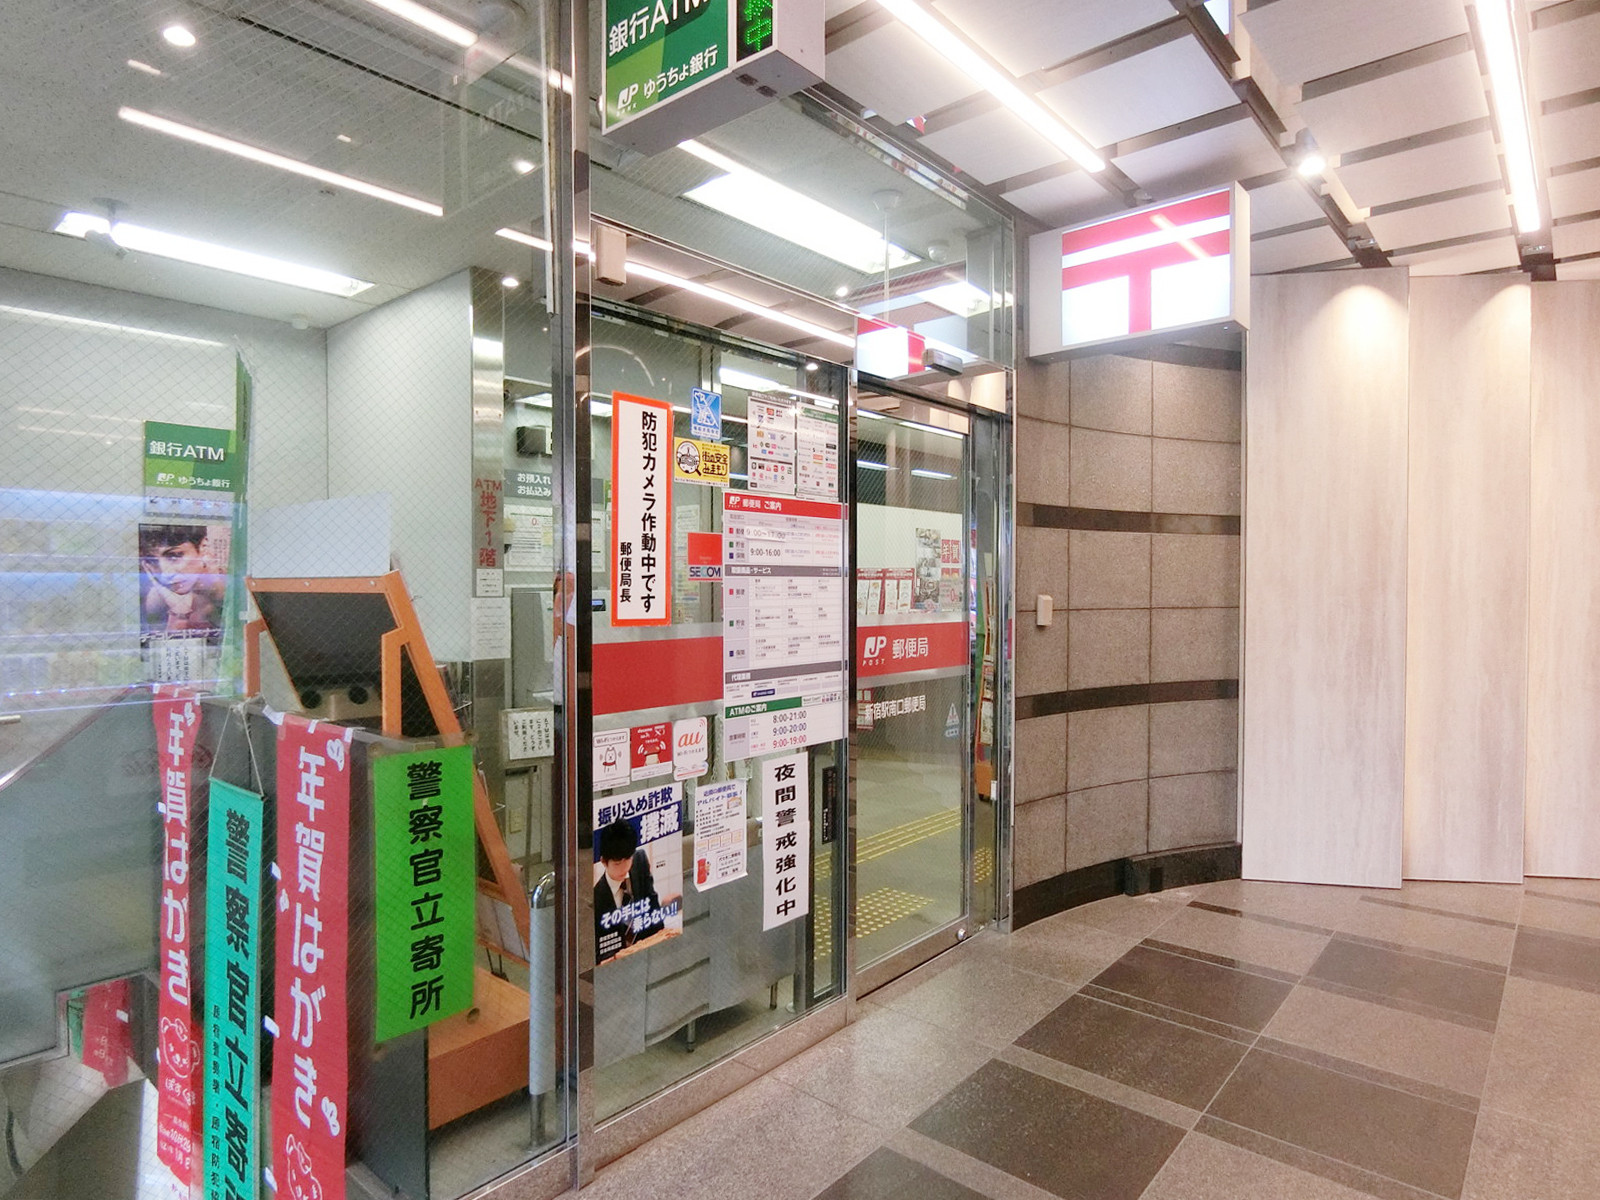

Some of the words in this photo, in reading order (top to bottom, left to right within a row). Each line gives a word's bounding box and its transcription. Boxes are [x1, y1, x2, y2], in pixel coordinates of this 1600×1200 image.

[643, 44, 718, 99] ゆうちょ銀行
[149, 440, 225, 461] 銀行ATM
[178, 476, 231, 488] ゆうちょ銀行
[475, 478, 502, 491] ATM
[517, 473, 551, 485] お預入れ
[517, 485, 551, 497] お払込み
[641, 410, 658, 613] 防犯カメラ作動中です
[742, 499, 761, 509] 郵便局
[764, 500, 782, 511] ご案内
[478, 491, 497, 568] 地下1階
[750, 548, 781, 557] 9:00-16:00
[619, 541, 632, 603] 郵便局長
[689, 566, 721, 578] SECOM
[864, 636, 887, 658] JP
[892, 637, 928, 660] 郵便局
[862, 659, 885, 667] POST
[772, 710, 807, 724] 8:00-21:00
[864, 695, 926, 722] 新宿駅南口郵便局
[678, 731, 704, 748] au
[772, 722, 807, 737] 9:00-20:00
[772, 734, 807, 749] 9:00-19:00
[598, 786, 673, 827] 振り込め詐欺
[640, 804, 679, 844] 撲滅
[774, 763, 798, 916] 夜間警戒強化中
[162, 707, 189, 1006] 年賀はがき
[407, 760, 445, 1020] 警察官立寄所
[600, 896, 651, 929] その手には
[289, 746, 327, 1129] 年賀はがき
